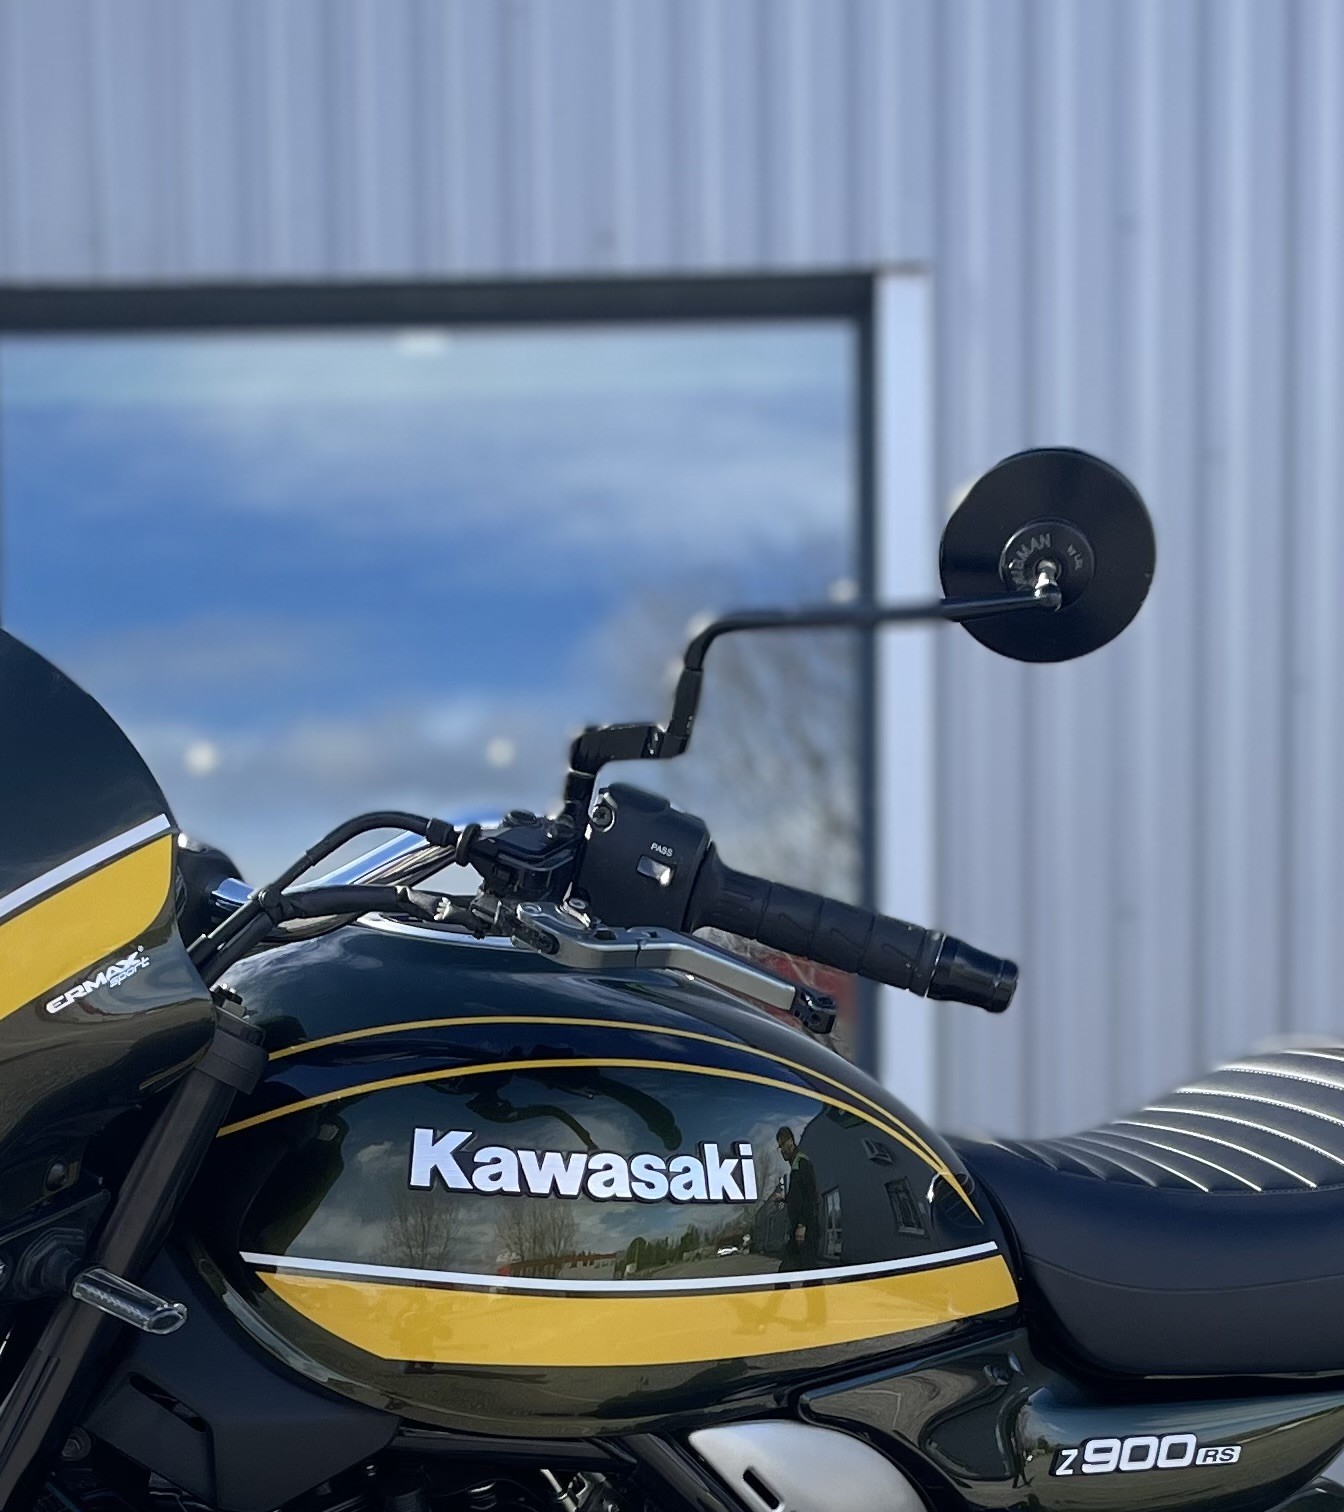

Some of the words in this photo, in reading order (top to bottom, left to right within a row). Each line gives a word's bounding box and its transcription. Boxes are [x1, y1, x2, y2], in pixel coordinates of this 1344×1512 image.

[650, 842, 673, 857] PASS
[46, 951, 140, 1013] ERMAX
[109, 957, 150, 988] sport
[409, 1127, 758, 1201] Kawasaki
